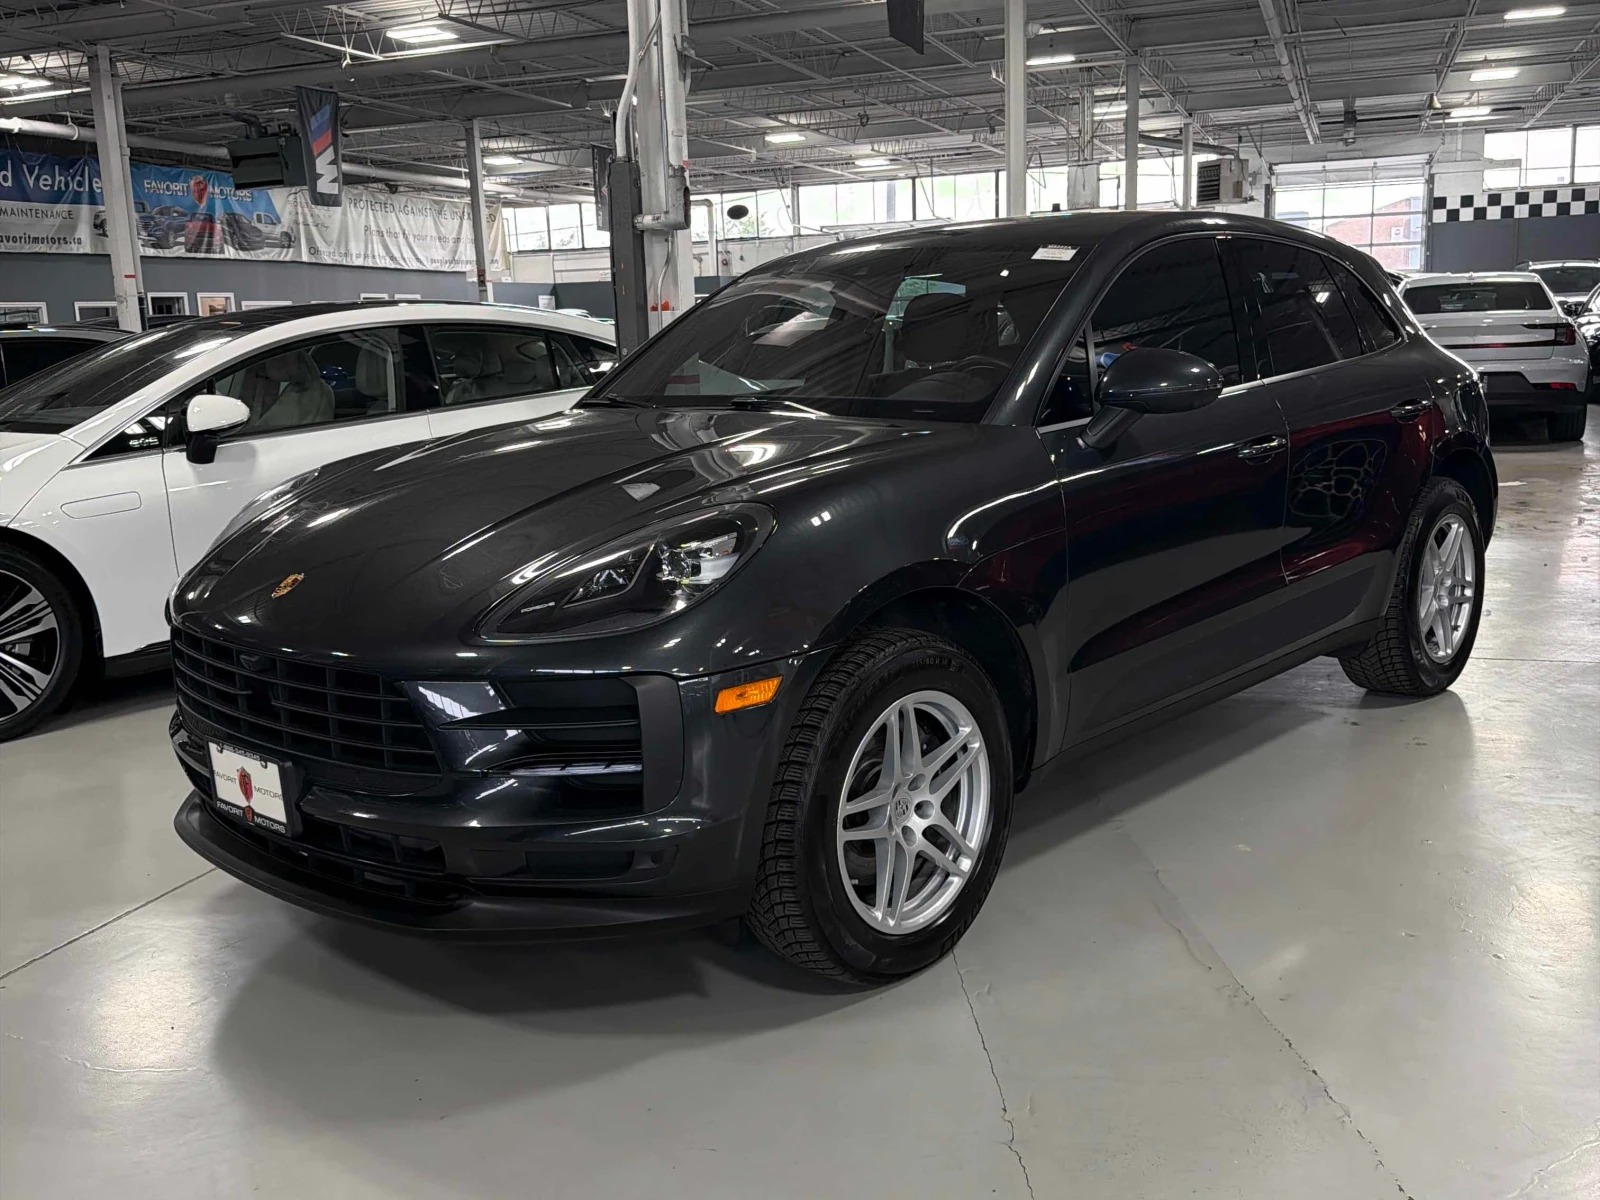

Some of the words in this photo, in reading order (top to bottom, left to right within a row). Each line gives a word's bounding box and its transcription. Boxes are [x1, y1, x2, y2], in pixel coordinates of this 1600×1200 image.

[22, 163, 102, 193] Vehicle
[144, 179, 189, 196] FAVORIT
[209, 186, 253, 201] MOTORS
[0, 208, 75, 220] MAINTENANCE
[348, 197, 395, 214] PROTECTED
[398, 203, 433, 218] AGAINST
[434, 209, 448, 220] THE
[364, 225, 385, 238] Plans
[412, 233, 428, 243] your
[520, 601, 556, 613] PORSCHE
[213, 769, 237, 785] FAVORIT
[253, 785, 284, 801] MOTORS
[216, 800, 244, 817] FAVORIT
[254, 815, 286, 834] MOTORS
